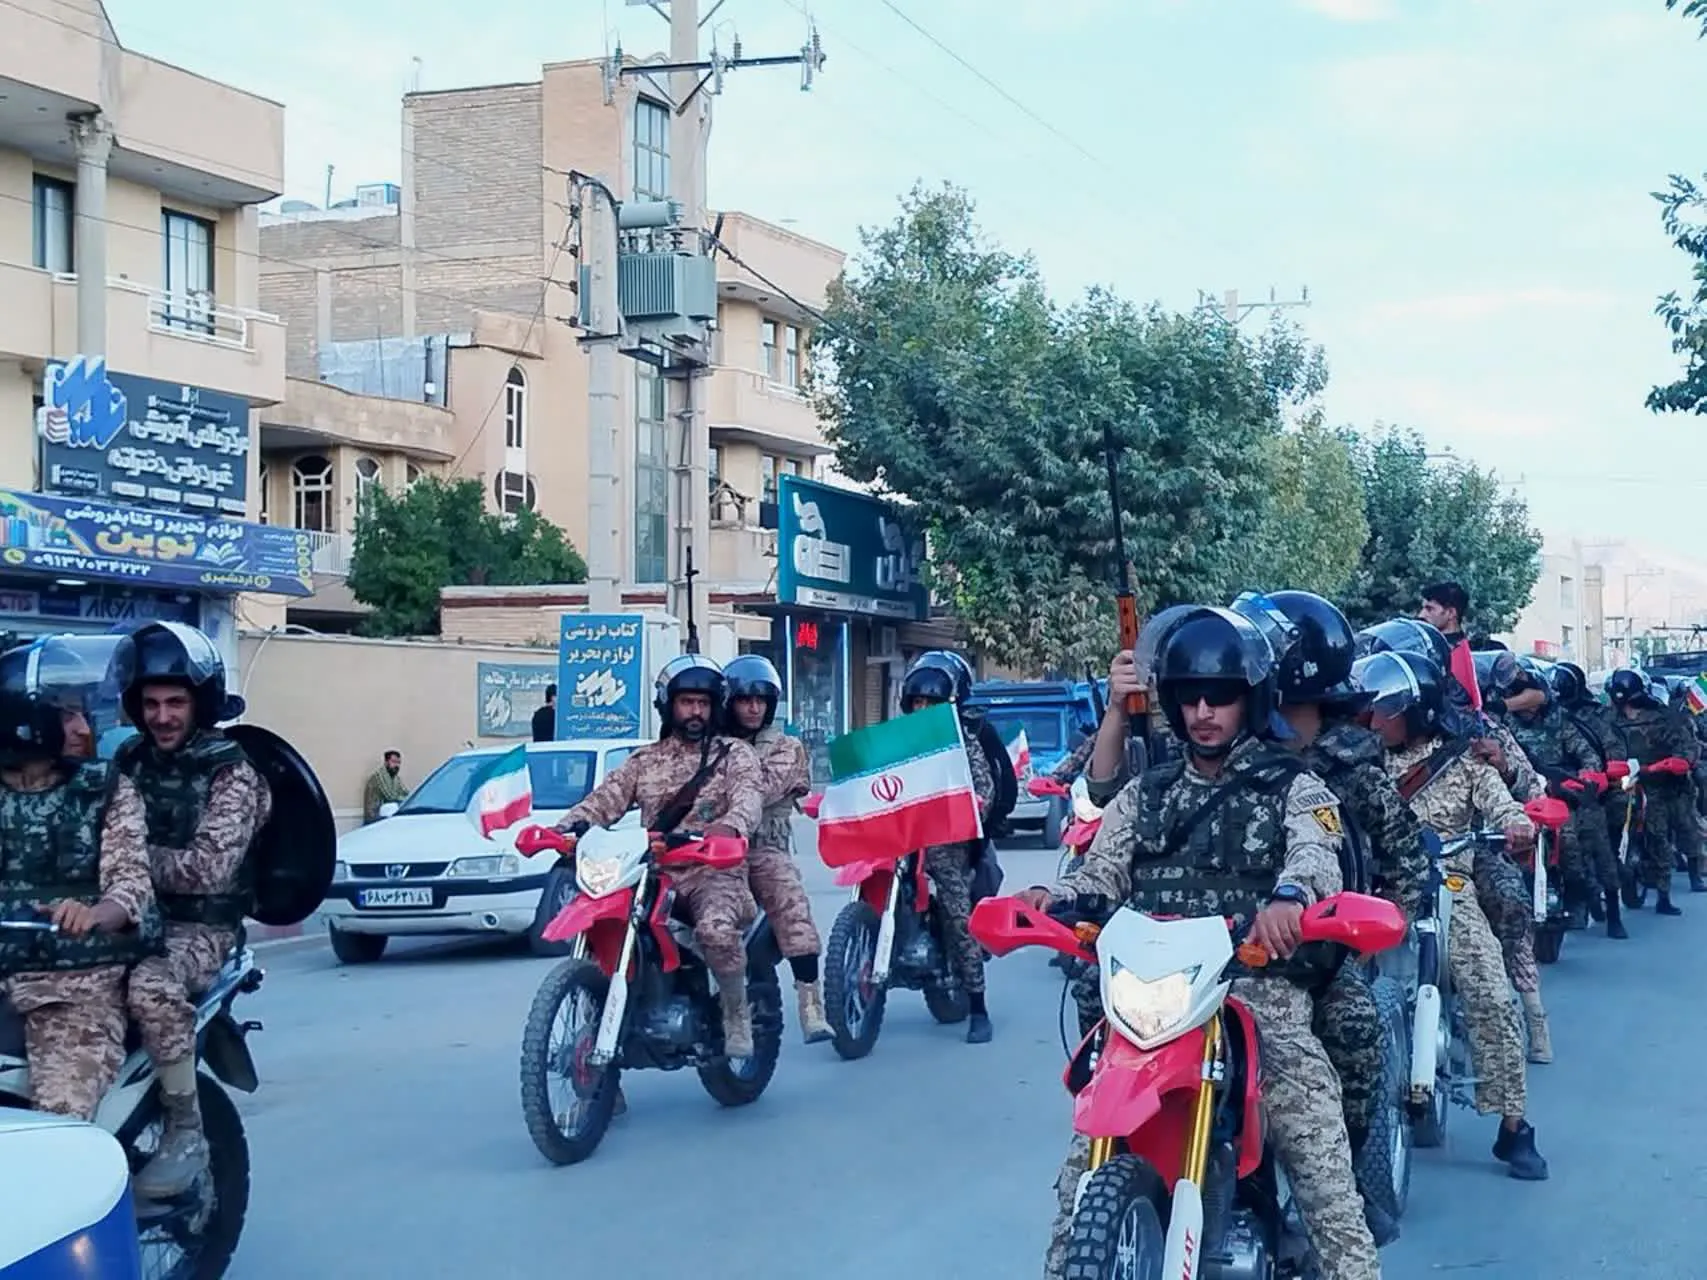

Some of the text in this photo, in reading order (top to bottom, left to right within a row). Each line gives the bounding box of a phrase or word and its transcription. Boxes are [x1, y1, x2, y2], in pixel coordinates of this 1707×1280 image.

[154, 518, 165, 531] و
[166, 519, 207, 534] تحریر
[206, 523, 244, 540] لوازم
[95, 524, 197, 560] نوین
[564, 622, 639, 641] کتاب فروشی
[566, 646, 635, 665] لوازم تحریر
